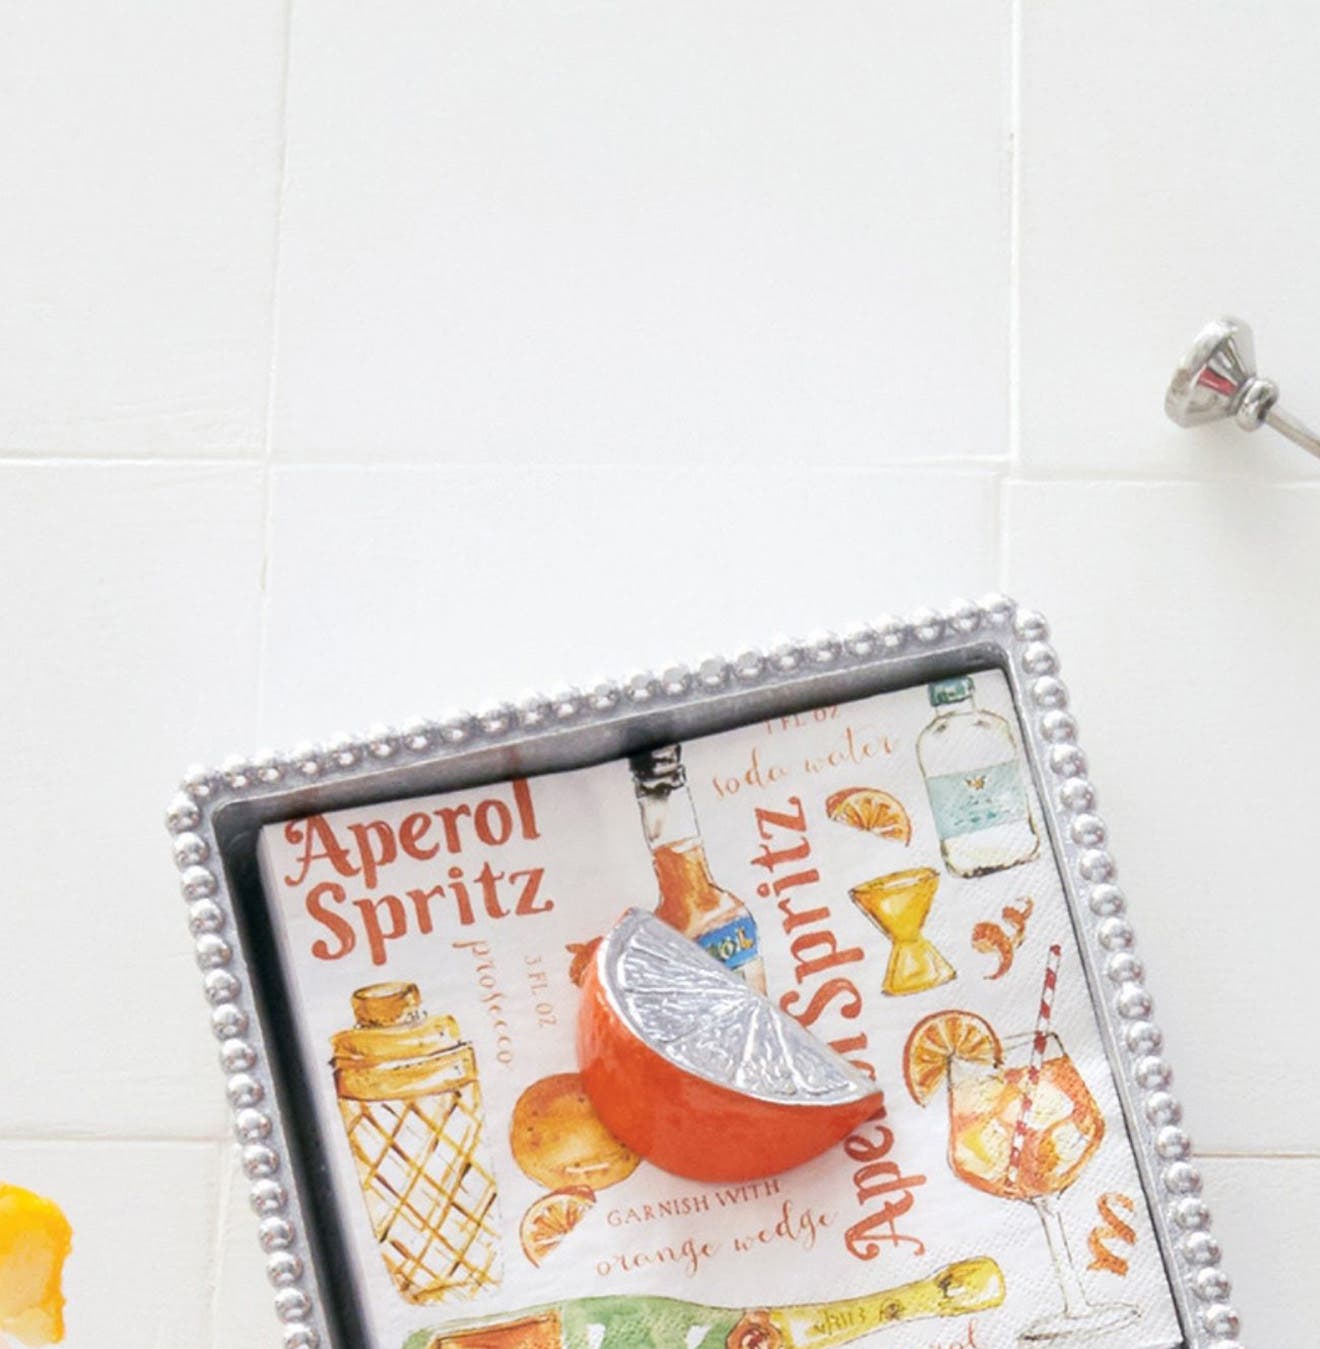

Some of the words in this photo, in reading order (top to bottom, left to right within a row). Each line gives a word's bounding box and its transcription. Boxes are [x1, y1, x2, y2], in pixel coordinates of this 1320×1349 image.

[284, 777, 541, 889] Aperol
[304, 860, 555, 966] Spritz
[751, 795, 865, 1030] Spritz
[596, 1238, 717, 1278] orange
[733, 1199, 837, 1252] wedge
[605, 1194, 710, 1228] GARNISH
[714, 1179, 783, 1208] WITH
